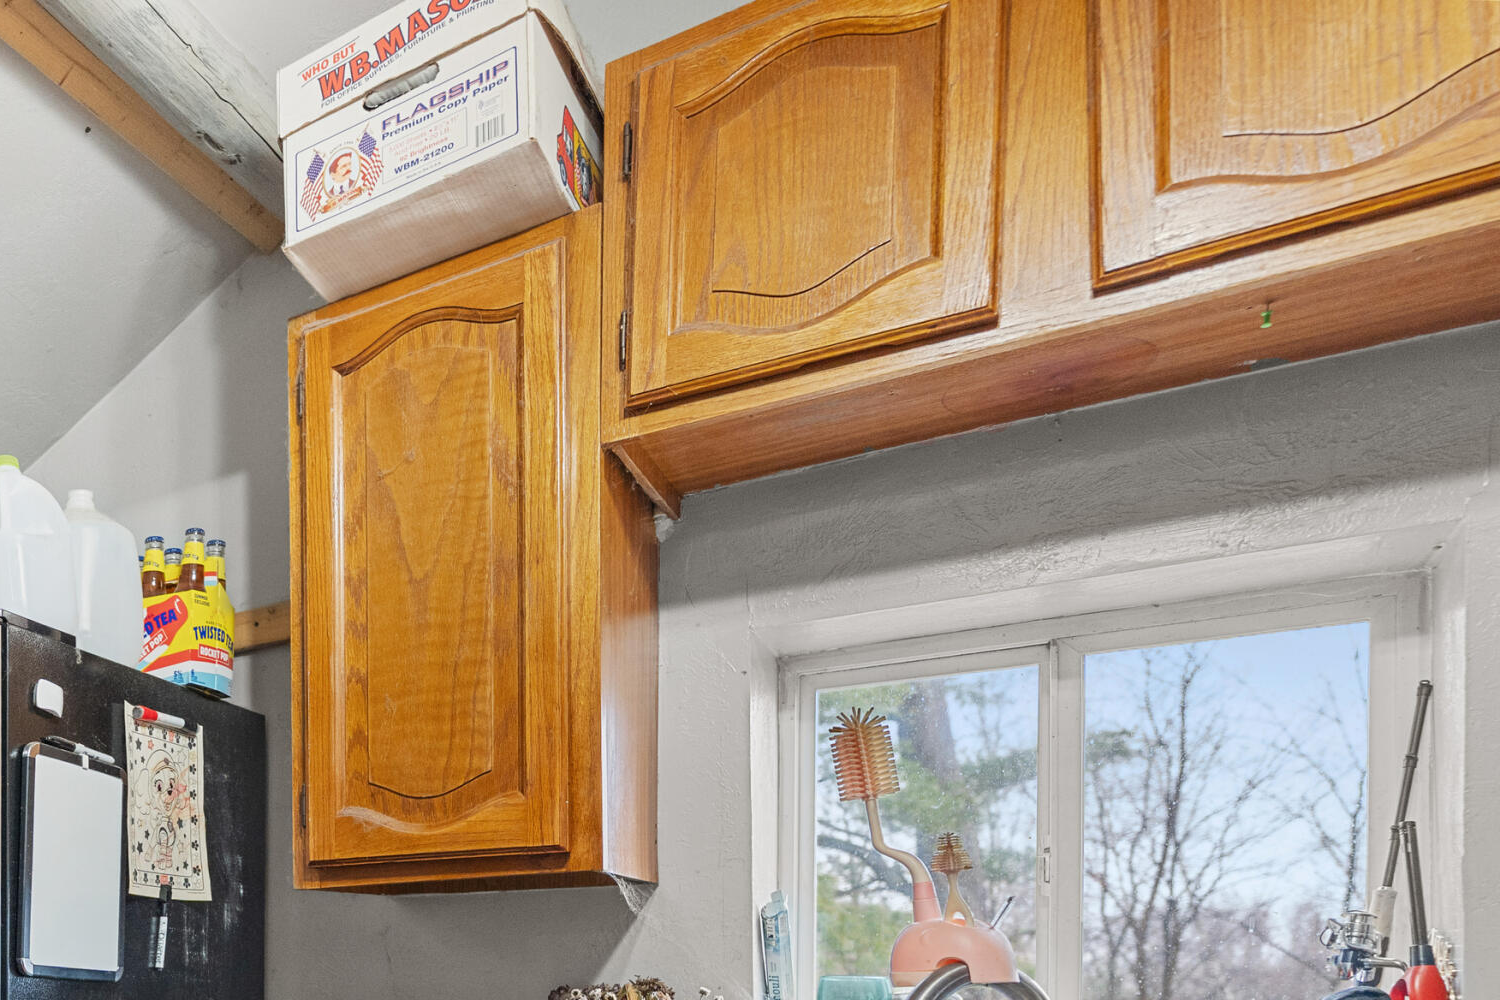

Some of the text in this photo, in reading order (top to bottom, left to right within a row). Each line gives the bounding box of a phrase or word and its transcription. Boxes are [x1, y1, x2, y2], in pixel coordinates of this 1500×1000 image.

[302, 42, 357, 81] WHO BUT
[321, 96, 335, 108] FOR
[337, 82, 362, 99] OFFICE
[403, 21, 446, 53] FURNITURE
[382, 60, 509, 131] FLAGSHIP
[382, 112, 434, 140] Premium
[438, 95, 468, 114] Copy
[472, 74, 509, 97] Paper
[394, 142, 454, 174] WBM-21200
[153, 609, 177, 629] TEA
[149, 633, 164, 648] POP
[193, 625, 225, 643] TWISTED
[226, 633, 234, 652] TEA
[200, 645, 229, 663] ROCKET POP
